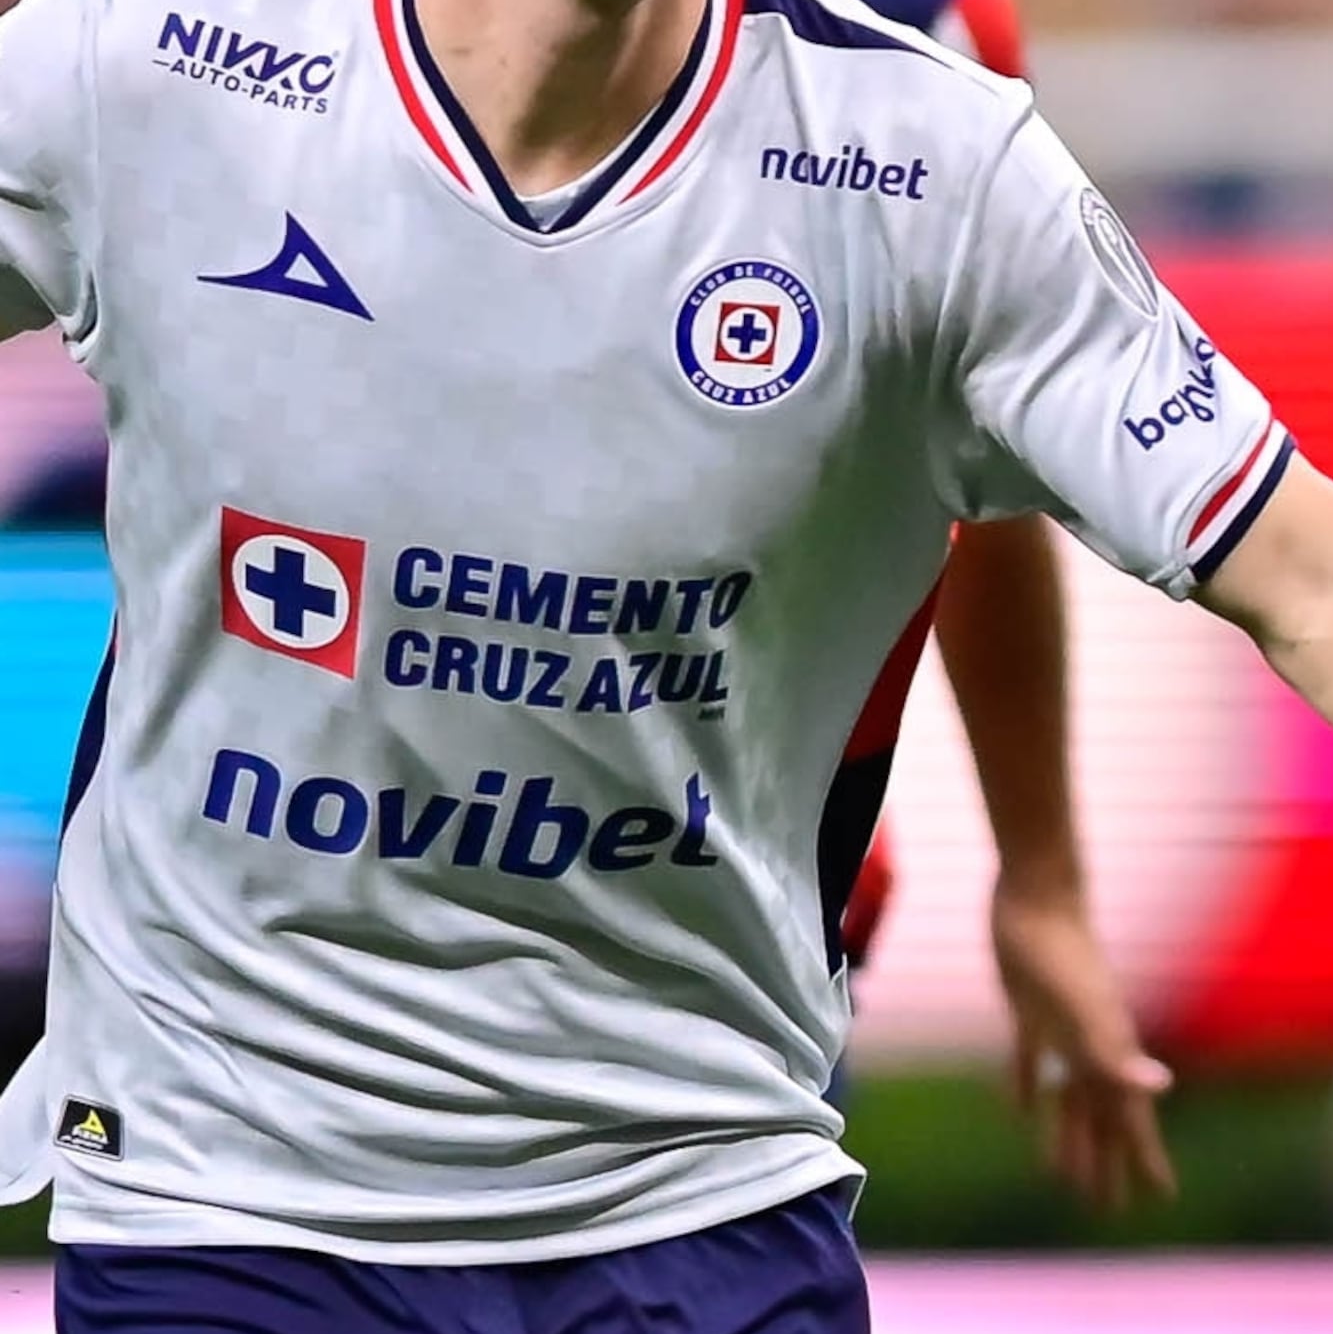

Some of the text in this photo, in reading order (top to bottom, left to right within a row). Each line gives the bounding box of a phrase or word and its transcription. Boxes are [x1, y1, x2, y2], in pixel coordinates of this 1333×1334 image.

[170, 58, 329, 114] AUTO-PARTS
[760, 145, 929, 200] novibet
[733, 265, 754, 277] DE
[691, 371, 791, 403] CRUZ AZUL
[394, 547, 754, 635] CEMENTO
[385, 630, 729, 714] CRUZ AZUL
[202, 748, 720, 880] novibet
